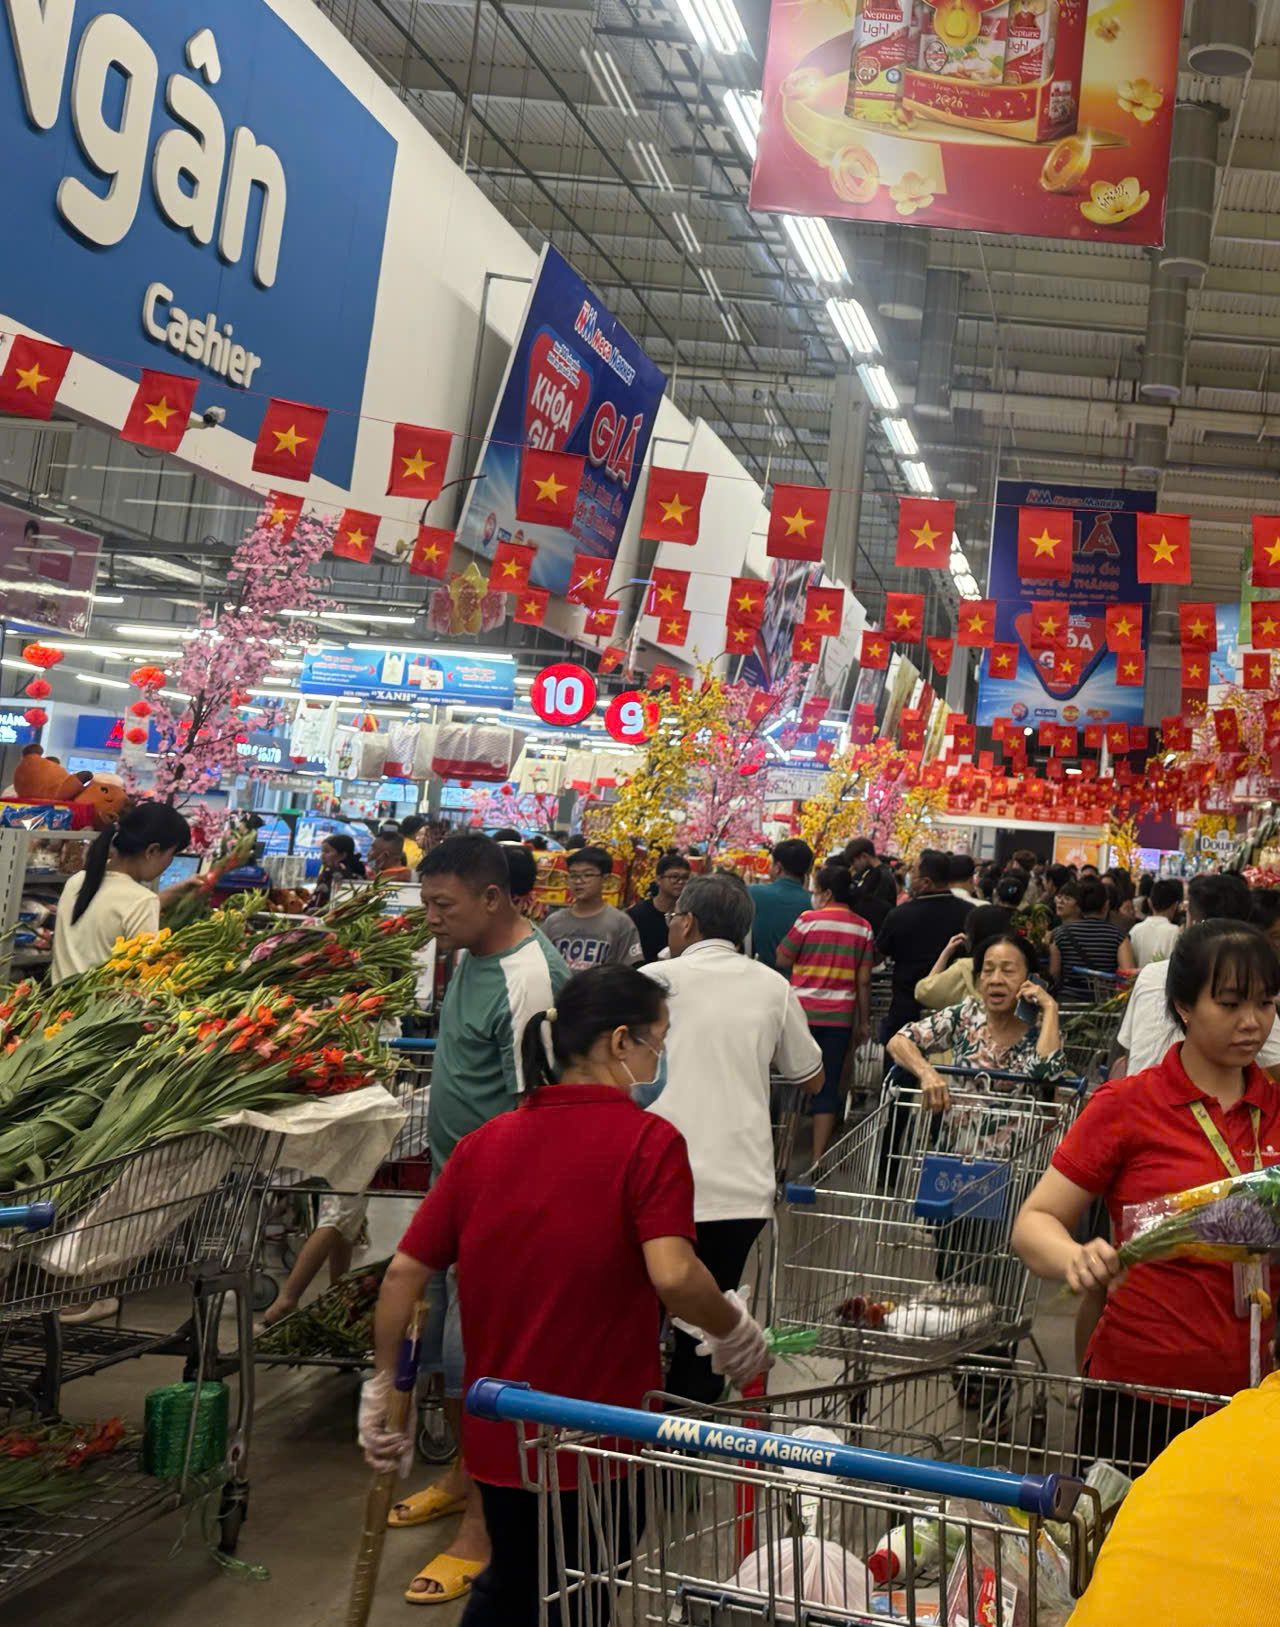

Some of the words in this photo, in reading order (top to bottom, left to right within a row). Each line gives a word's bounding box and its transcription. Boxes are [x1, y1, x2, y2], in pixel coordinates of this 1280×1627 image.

[863, 9, 902, 22] Neptune
[1009, 28, 1040, 39] Neptune
[141, 282, 261, 389] Cashier
[530, 373, 575, 433] KHÓA
[590, 401, 644, 490] GIÁ
[543, 676, 585, 715] 10
[620, 702, 644, 735] 9
[704, 1429, 757, 1454] Mega
[759, 1438, 837, 1467] Market
